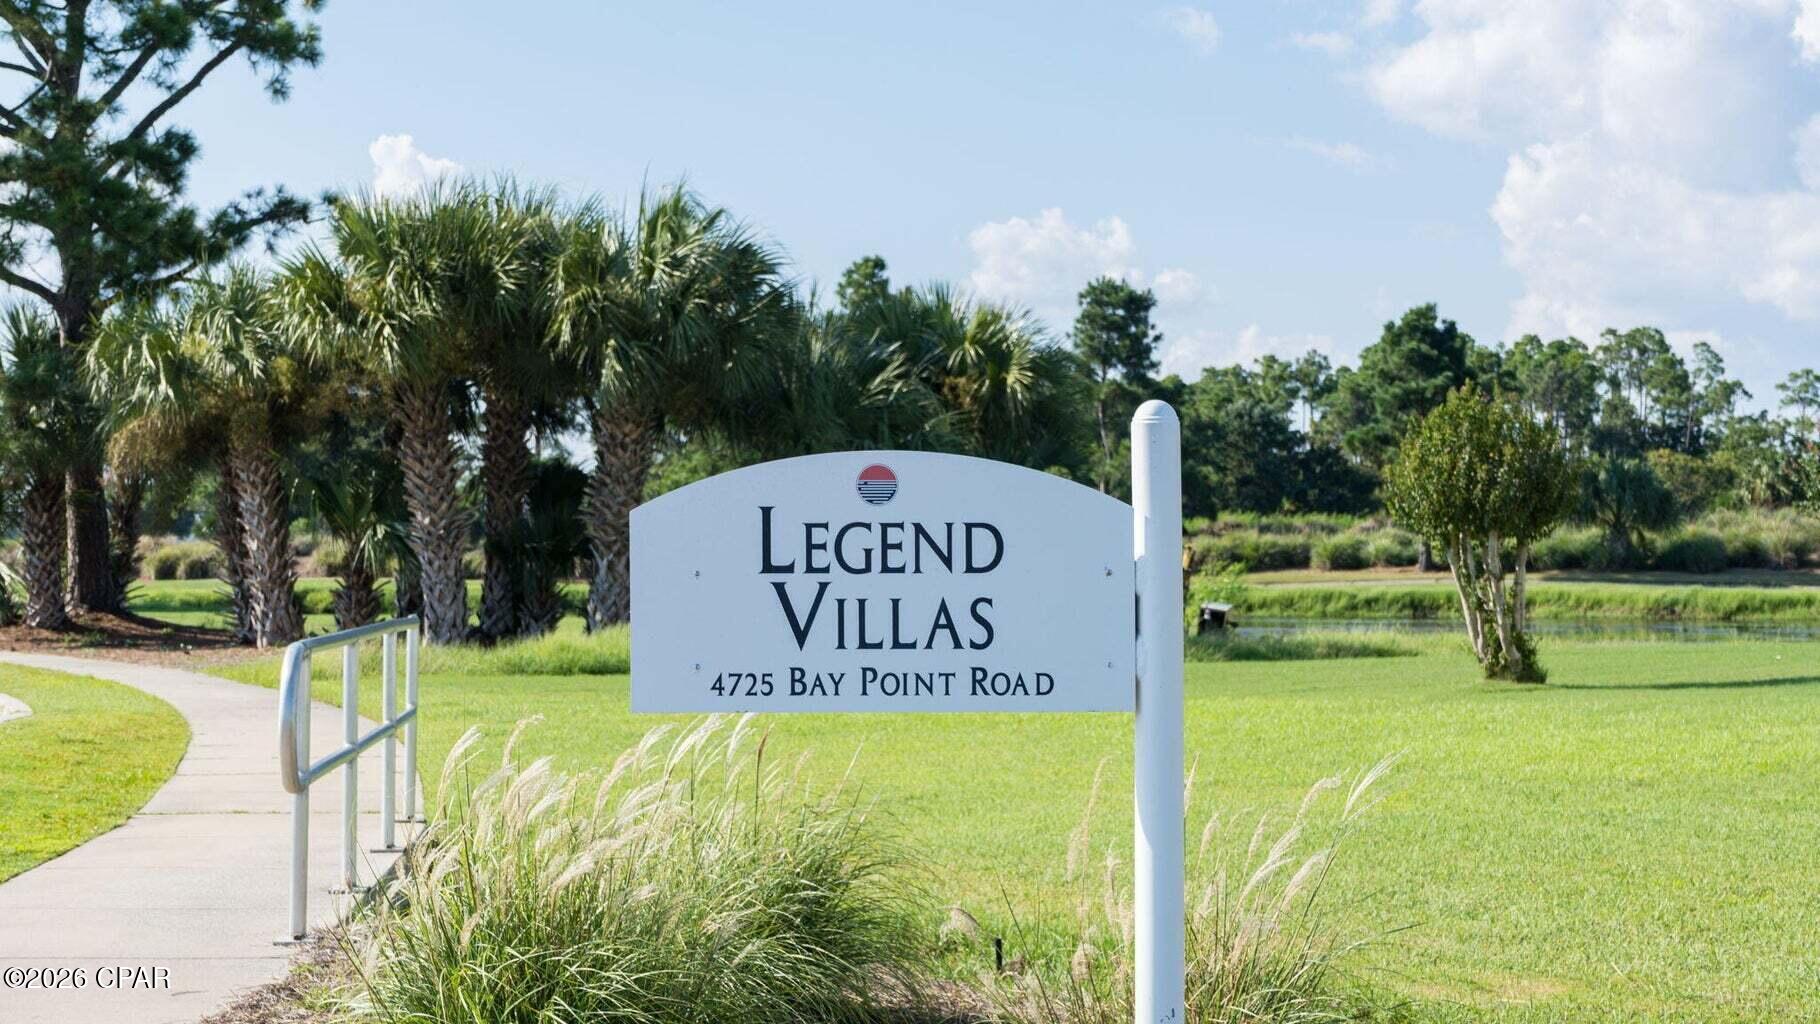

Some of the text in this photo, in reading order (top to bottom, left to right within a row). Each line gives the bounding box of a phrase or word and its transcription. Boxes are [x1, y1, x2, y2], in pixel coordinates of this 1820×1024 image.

[758, 506, 1004, 574] LEGEND
[770, 581, 994, 651] VILLAS
[710, 666, 1055, 697] 4725 BAY POINT ROAD
